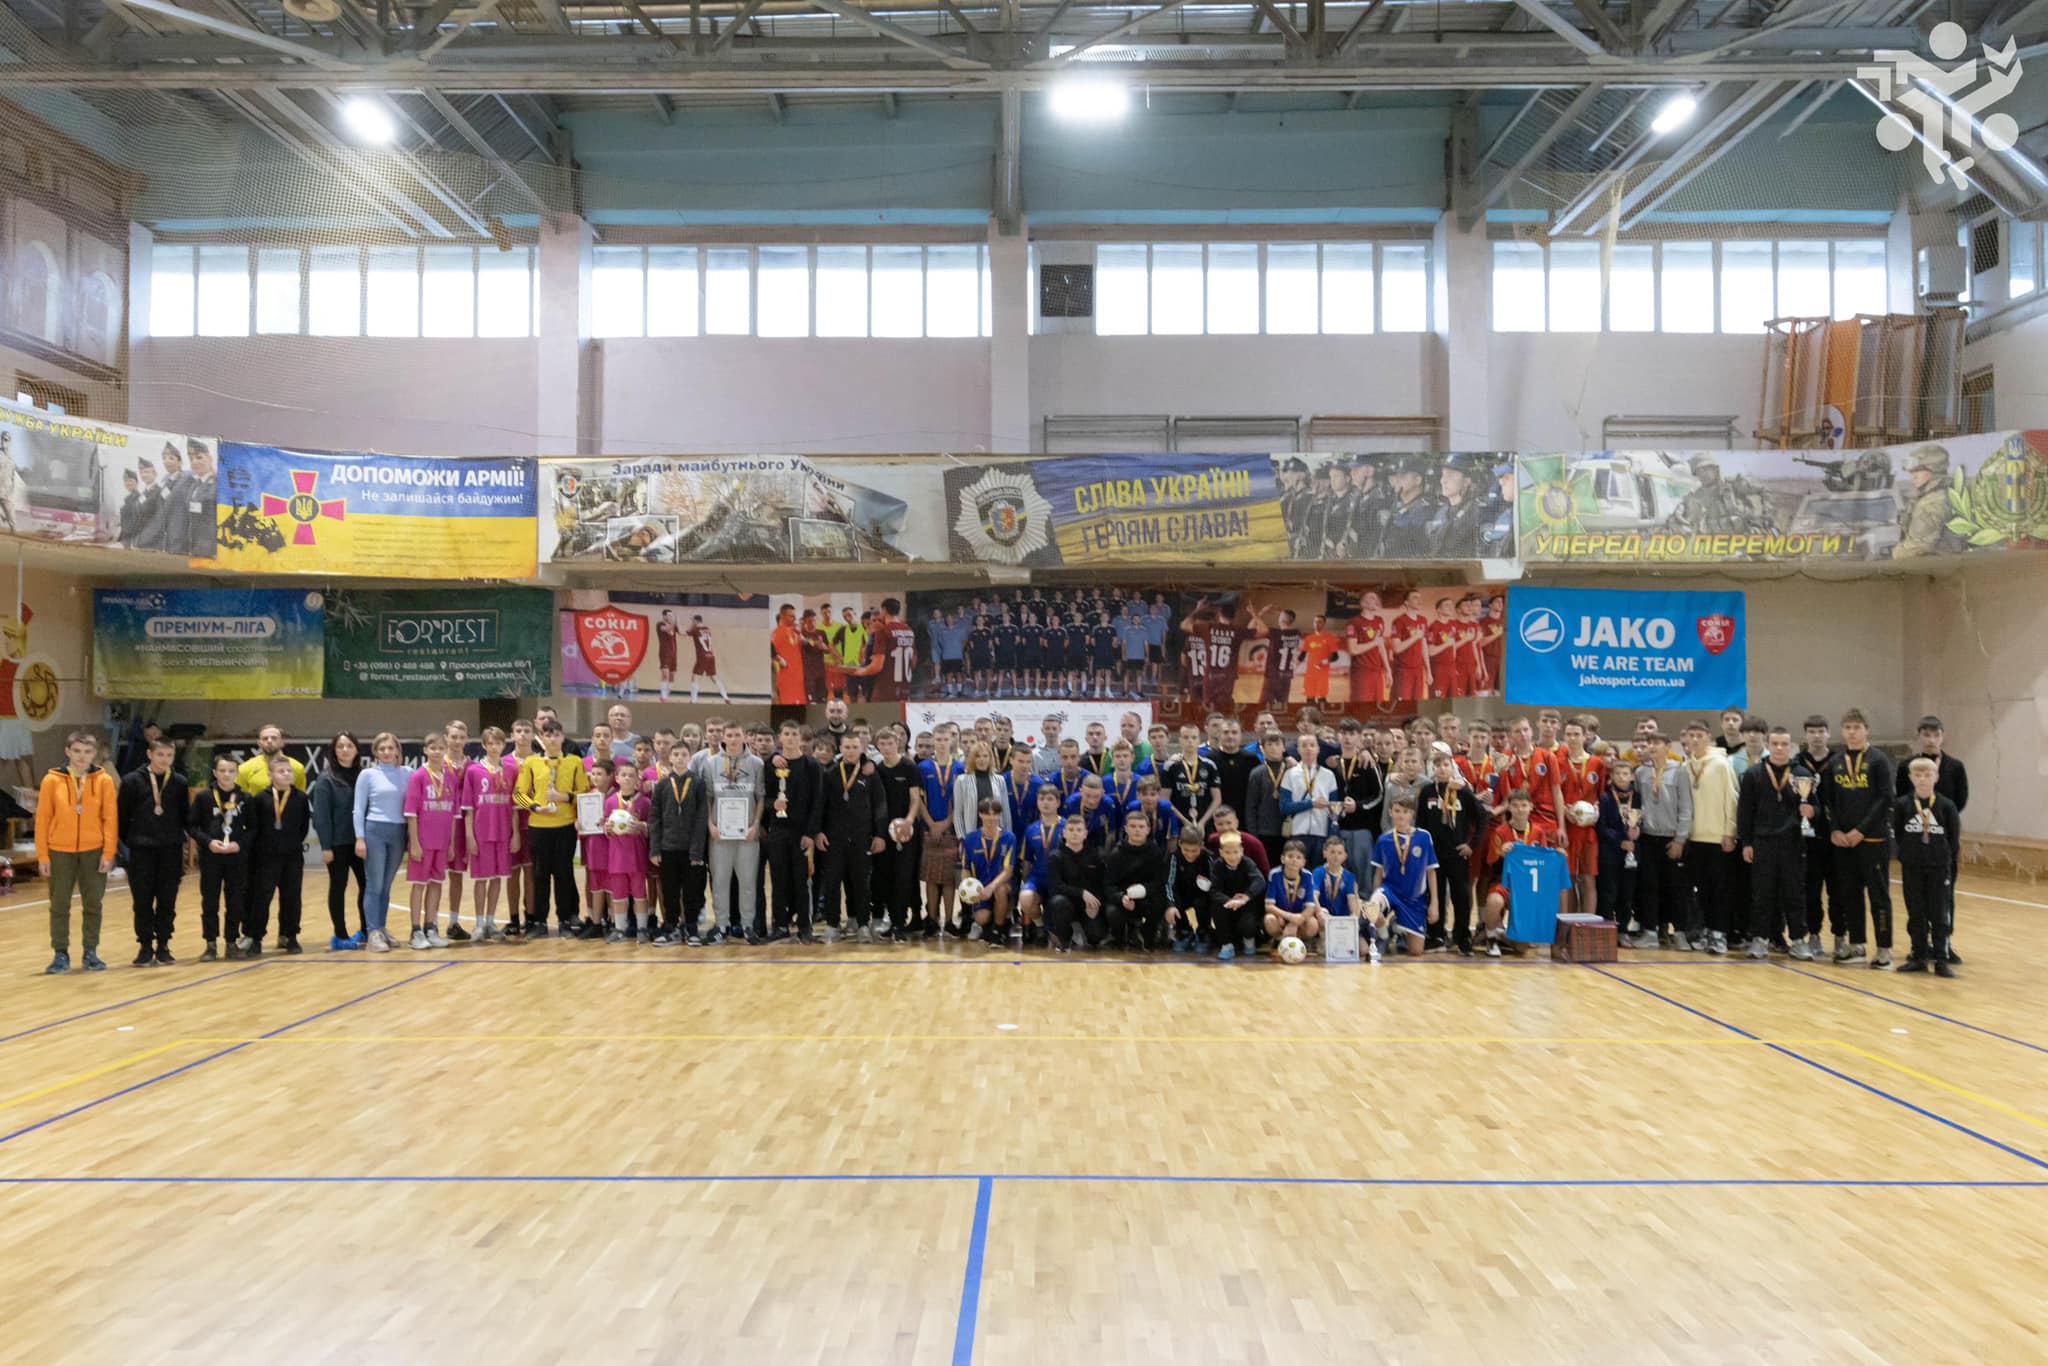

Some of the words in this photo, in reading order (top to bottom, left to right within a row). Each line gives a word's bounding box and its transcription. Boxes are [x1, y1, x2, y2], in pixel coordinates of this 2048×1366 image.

[49, 423, 128, 447] УКРАЇНИ
[330, 464, 460, 487] ДОПОМОЖИ
[464, 465, 525, 488] АРМІЇ!
[612, 461, 672, 477] Заради
[678, 459, 785, 475] майбутнього
[362, 489, 379, 502] Не
[383, 491, 454, 505] залишайся
[457, 492, 524, 508] байдужим!
[1074, 478, 1145, 514] СЛАВА
[1150, 467, 1249, 503] УКРАЇНІ!
[1082, 516, 1161, 552] ГЕРОЯМ
[1167, 510, 1250, 544] СЛАВА!
[1535, 535, 1641, 558] УПЕРЕД
[1646, 535, 1686, 558] ДО
[1694, 534, 1841, 555] ПЕРЕМОГИ
[153, 621, 266, 633] ПРЕМІУМ-ЛІГА
[584, 616, 638, 630] СОКІЛ
[1573, 616, 1676, 649] JAKO
[1571, 654, 1600, 670] WE
[1603, 655, 1639, 671] ARE
[1644, 657, 1694, 672] TEAM
[1579, 674, 1685, 688] jakosport.com.ua
[1834, 773, 1868, 785] QAAR
[1904, 822, 1945, 835] adias
[1529, 867, 1539, 893] 1
